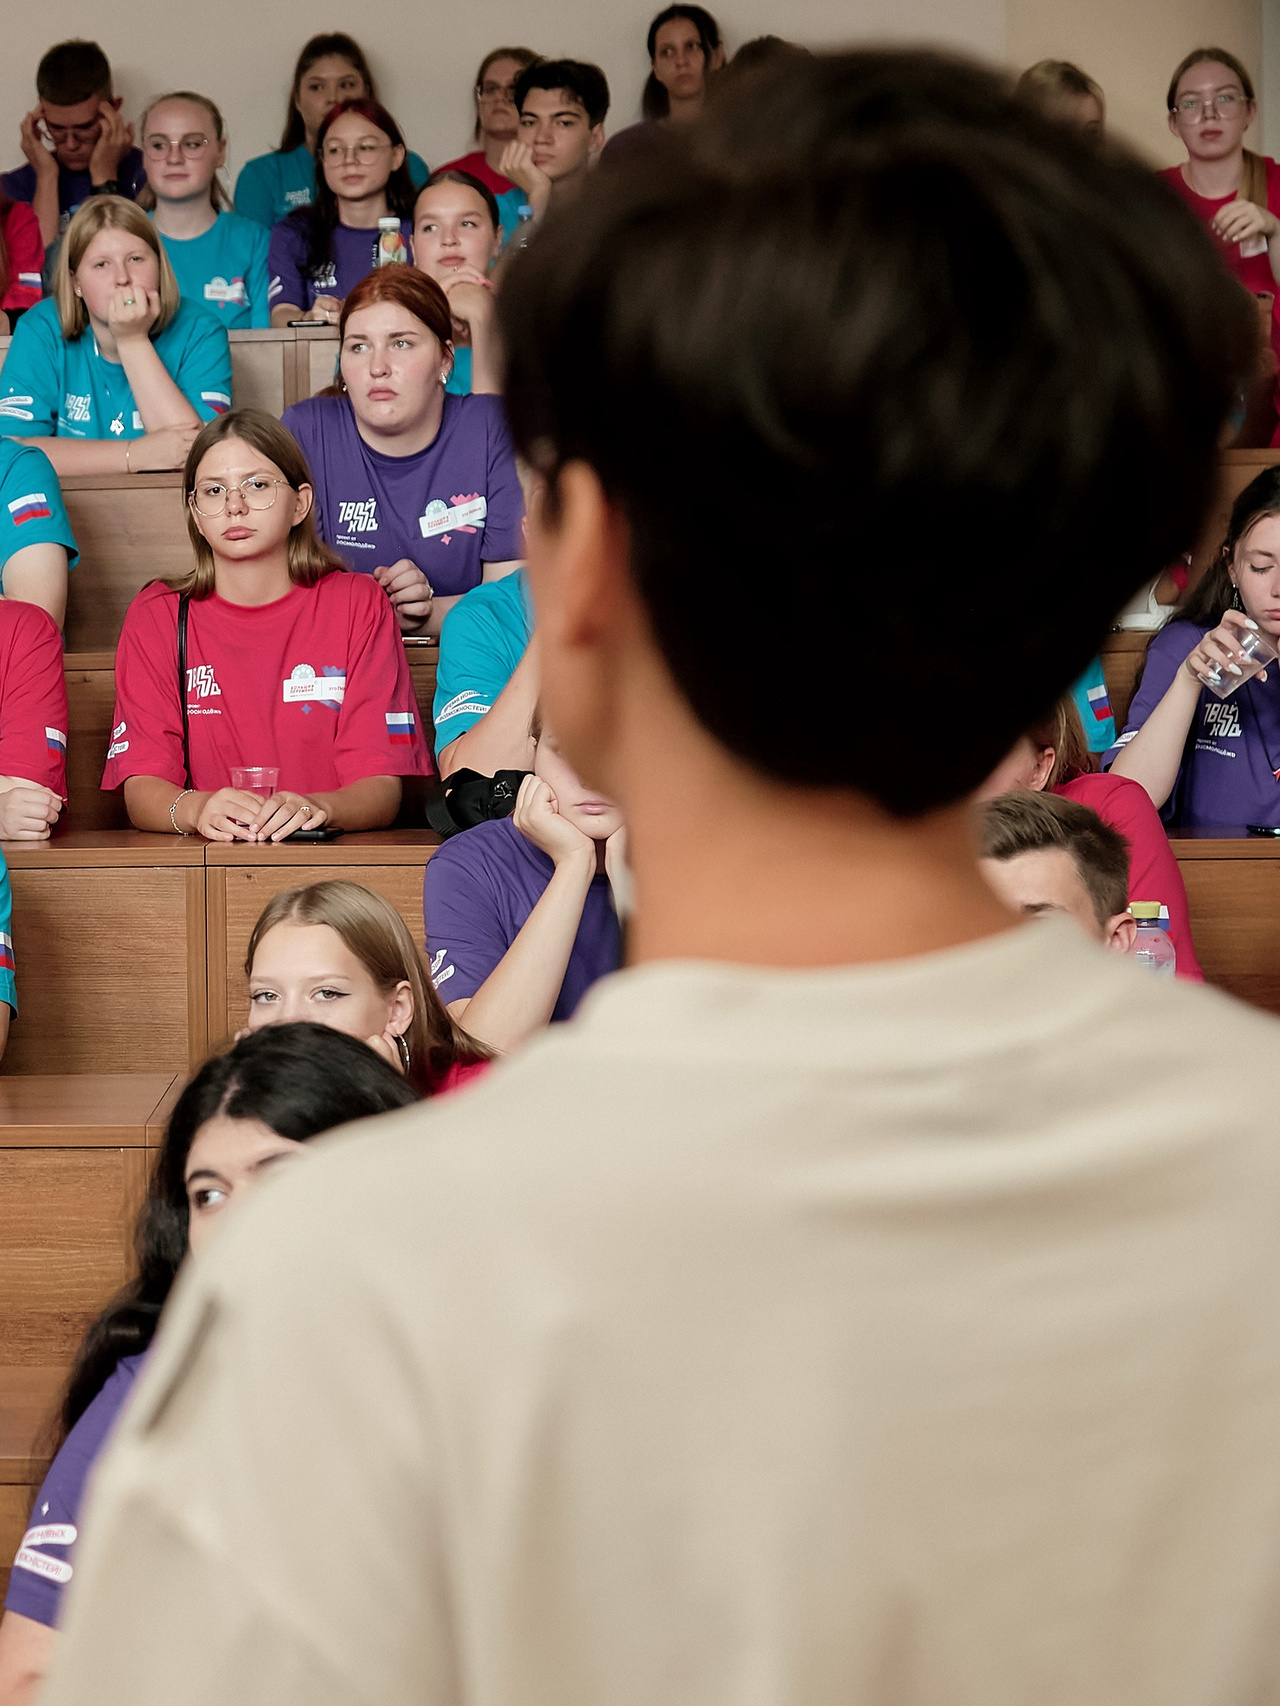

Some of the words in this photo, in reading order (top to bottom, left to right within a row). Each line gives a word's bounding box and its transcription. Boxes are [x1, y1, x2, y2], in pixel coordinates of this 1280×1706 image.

[338, 498, 376, 524] ТВОЙ
[347, 518, 378, 533] ХОД
[1203, 701, 1239, 727] ТВОЙ
